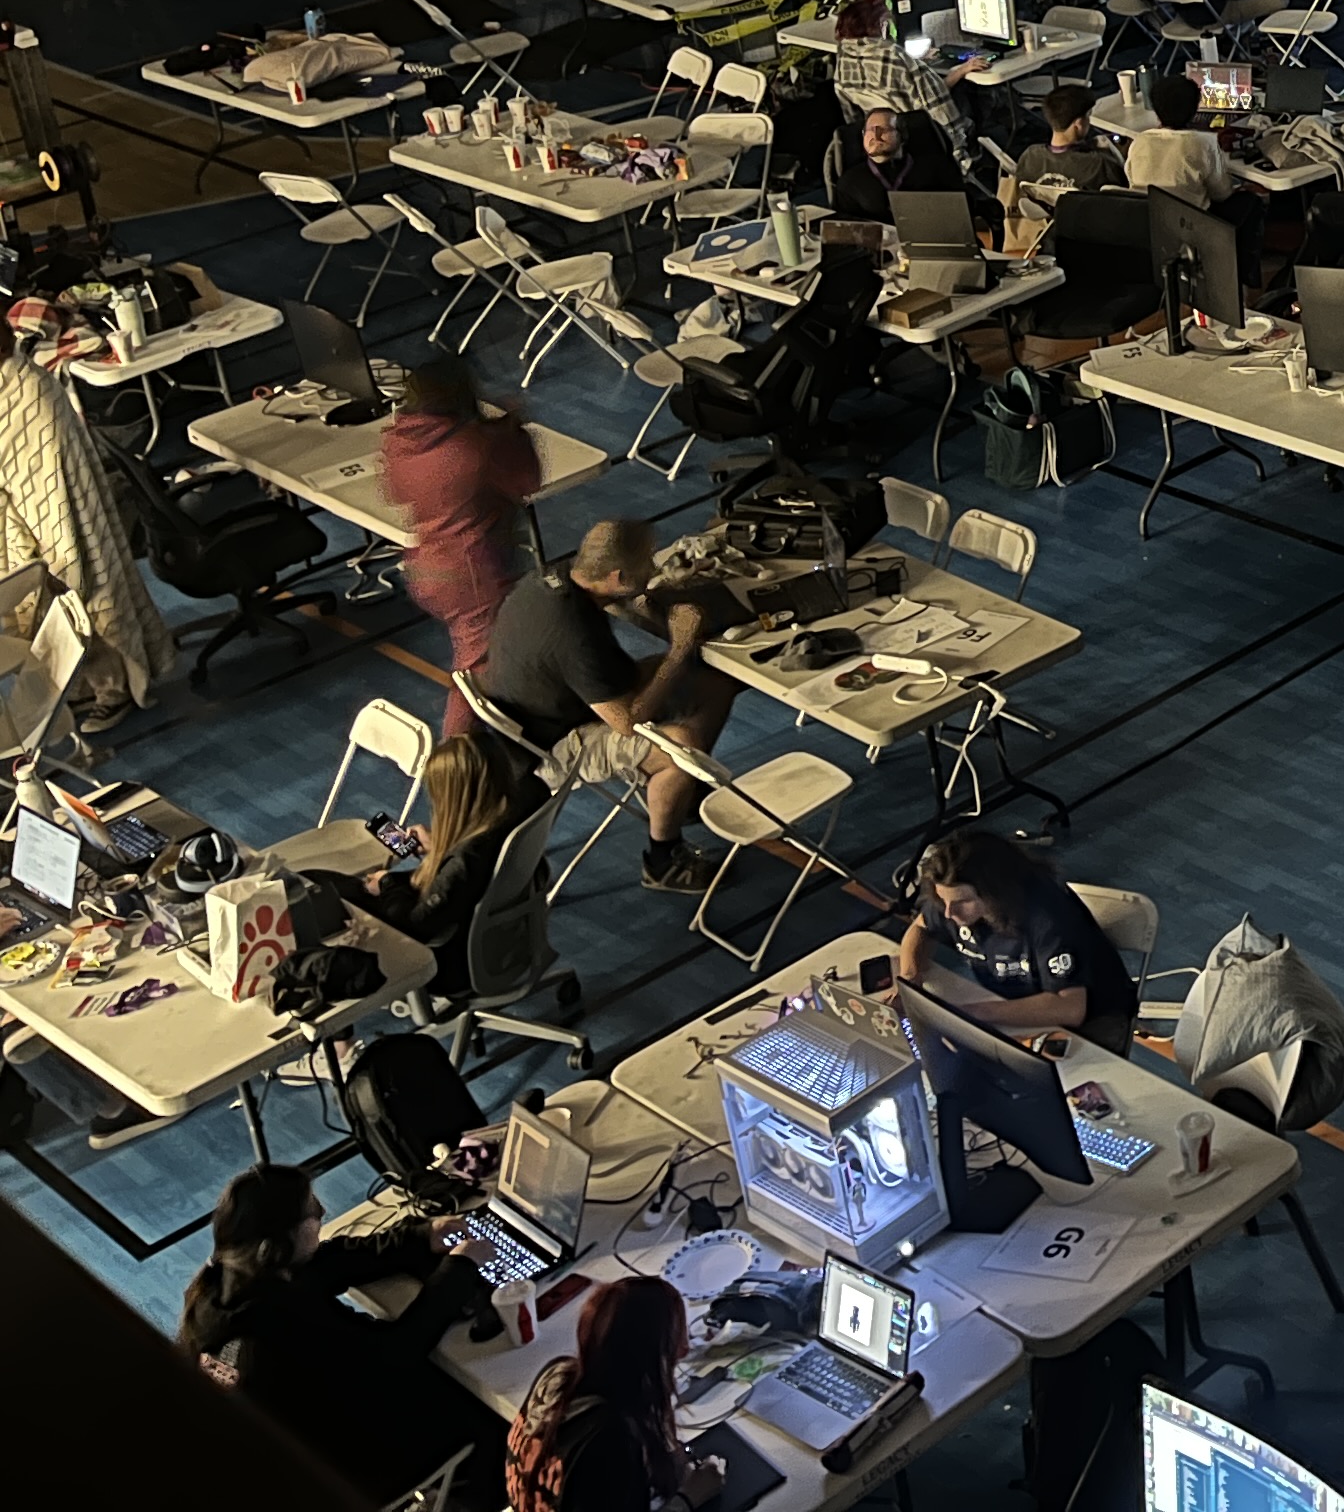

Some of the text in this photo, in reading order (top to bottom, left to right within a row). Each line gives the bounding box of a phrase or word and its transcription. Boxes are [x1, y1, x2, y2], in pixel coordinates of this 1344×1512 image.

[705, 29, 729, 44] TION
[956, 628, 993, 643] F6
[1042, 1226, 1085, 1259] G6
[1161, 1237, 1203, 1274] LEGACY
[862, 1446, 911, 1486] LEGACY
